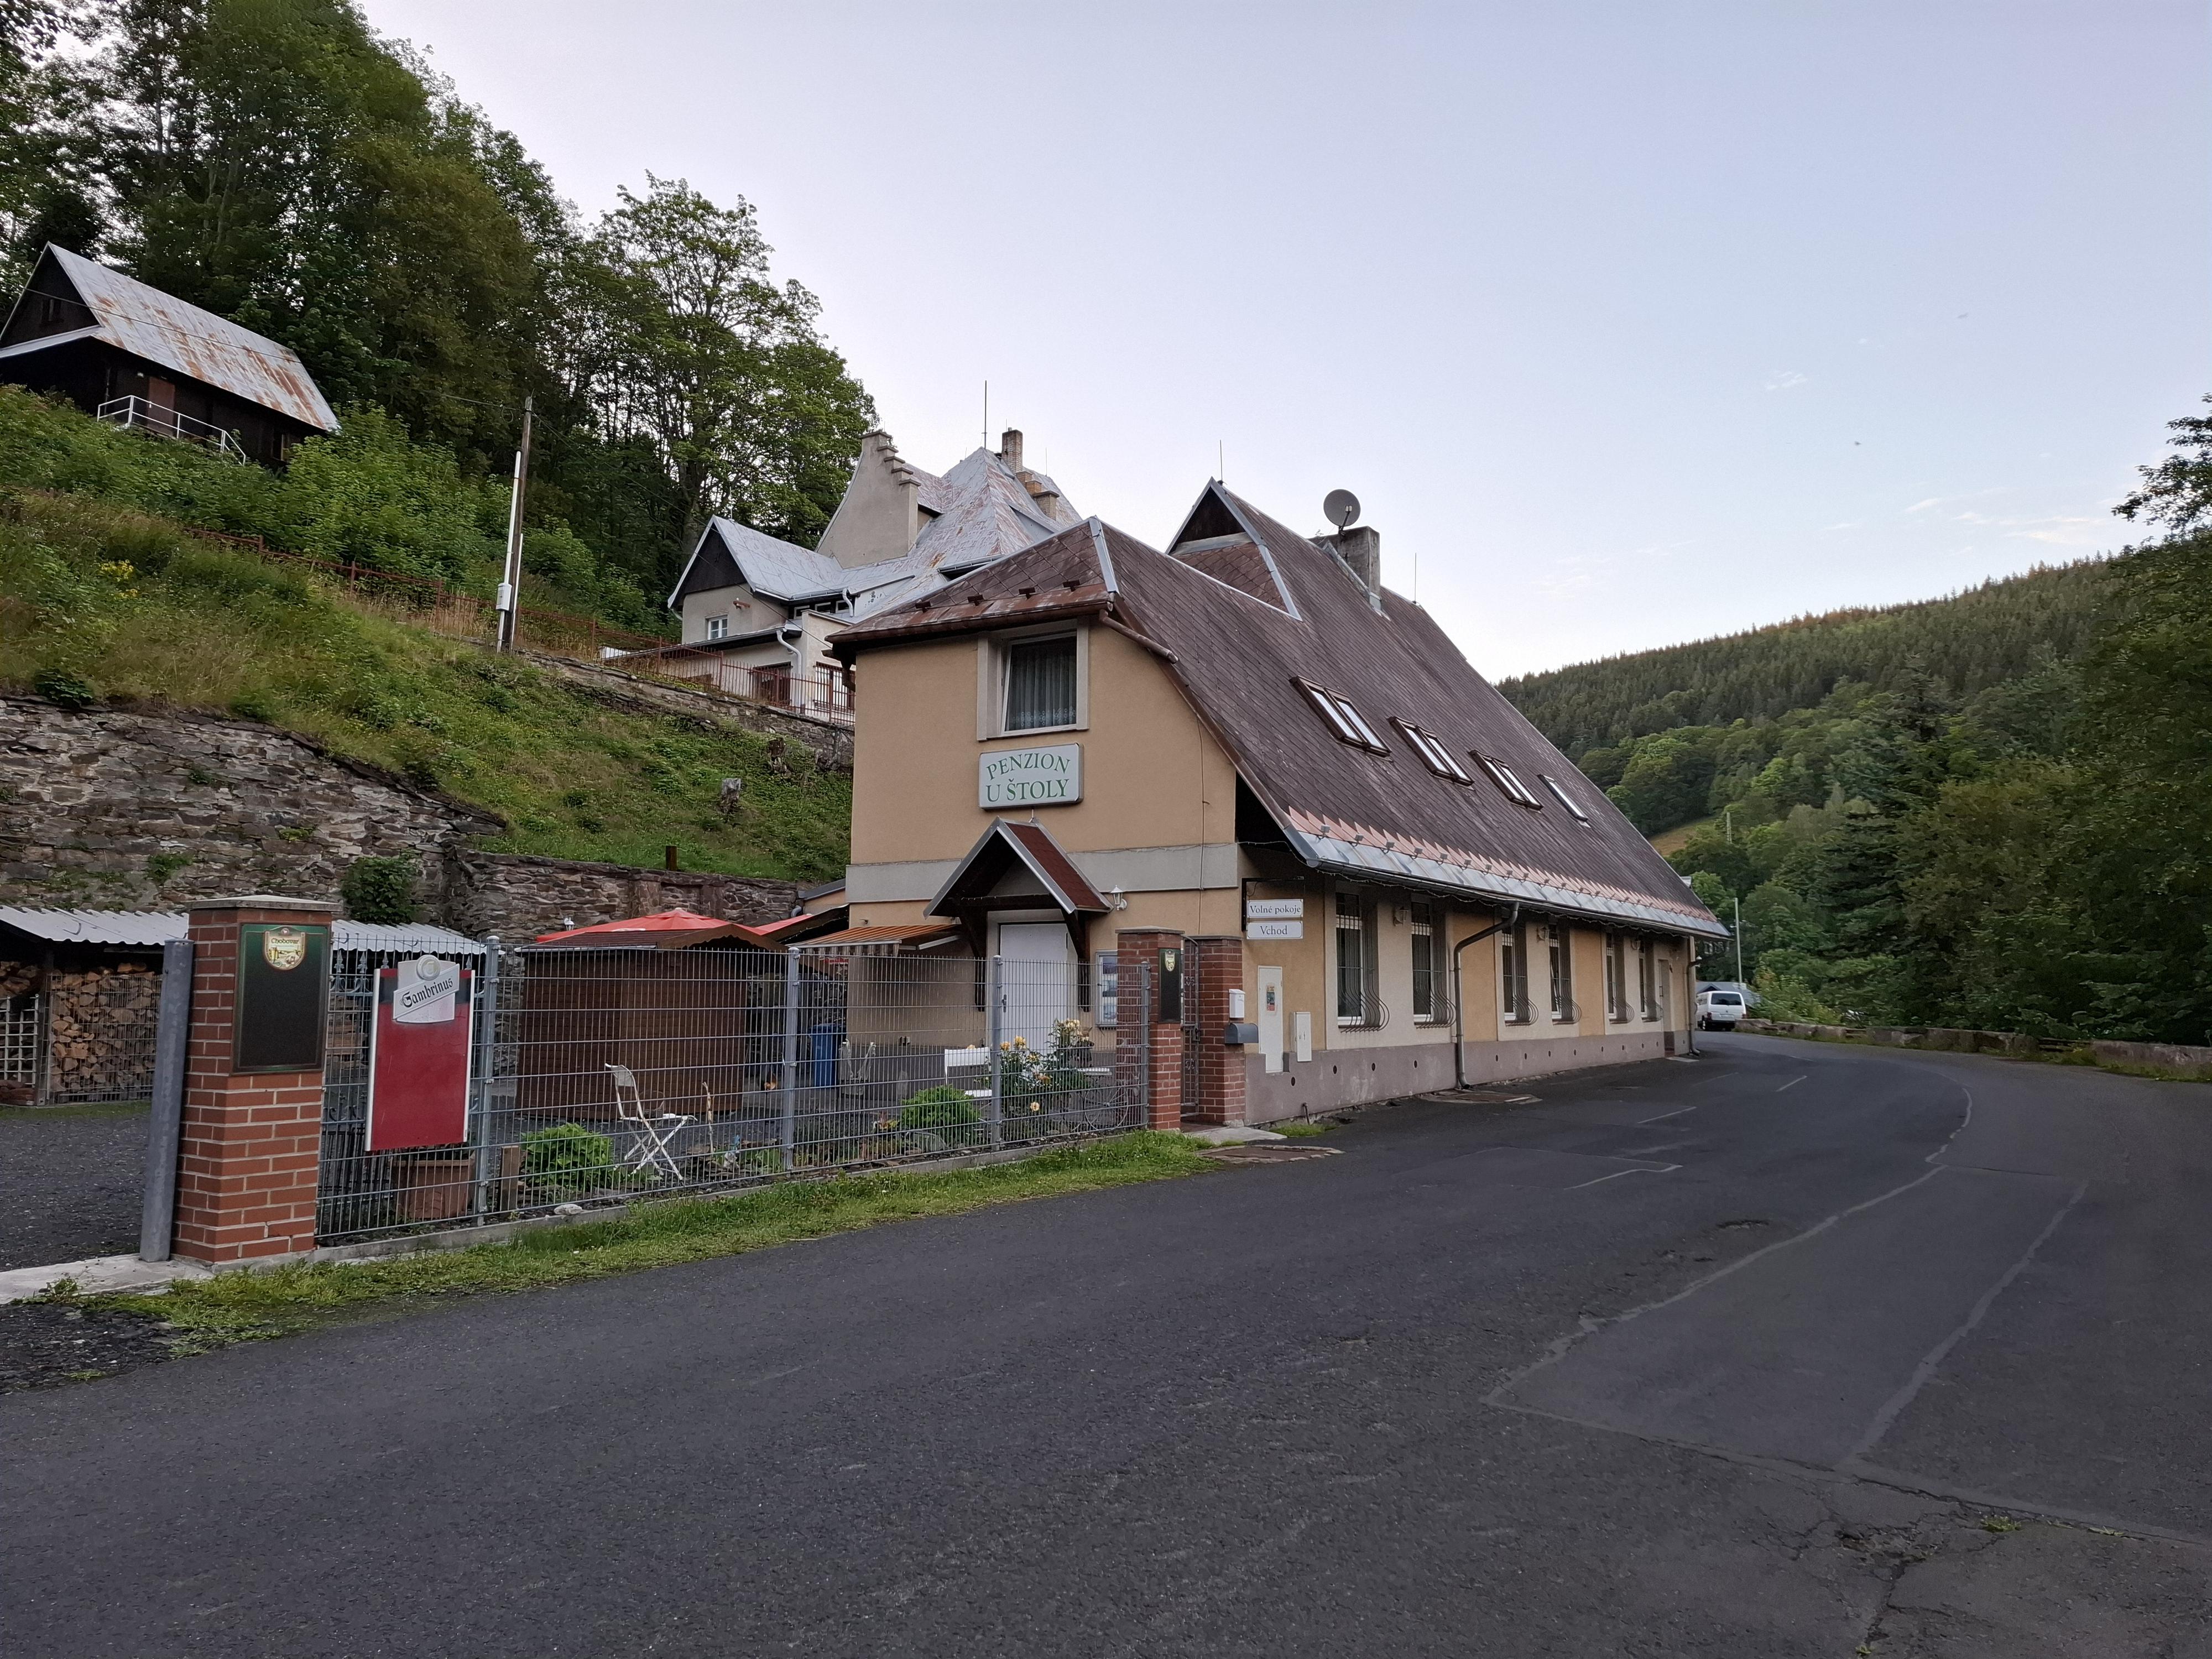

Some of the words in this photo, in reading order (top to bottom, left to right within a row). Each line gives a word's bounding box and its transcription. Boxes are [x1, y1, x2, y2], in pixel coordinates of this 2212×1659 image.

[986, 753, 1070, 780] PENZION
[986, 784, 1001, 802] U
[1006, 778, 1070, 801] ŠTOLY
[1250, 905, 1272, 914] Volné
[1275, 905, 1301, 914] pokoje
[1260, 925, 1287, 935] Vchod
[402, 978, 453, 1008] Gambrinus
